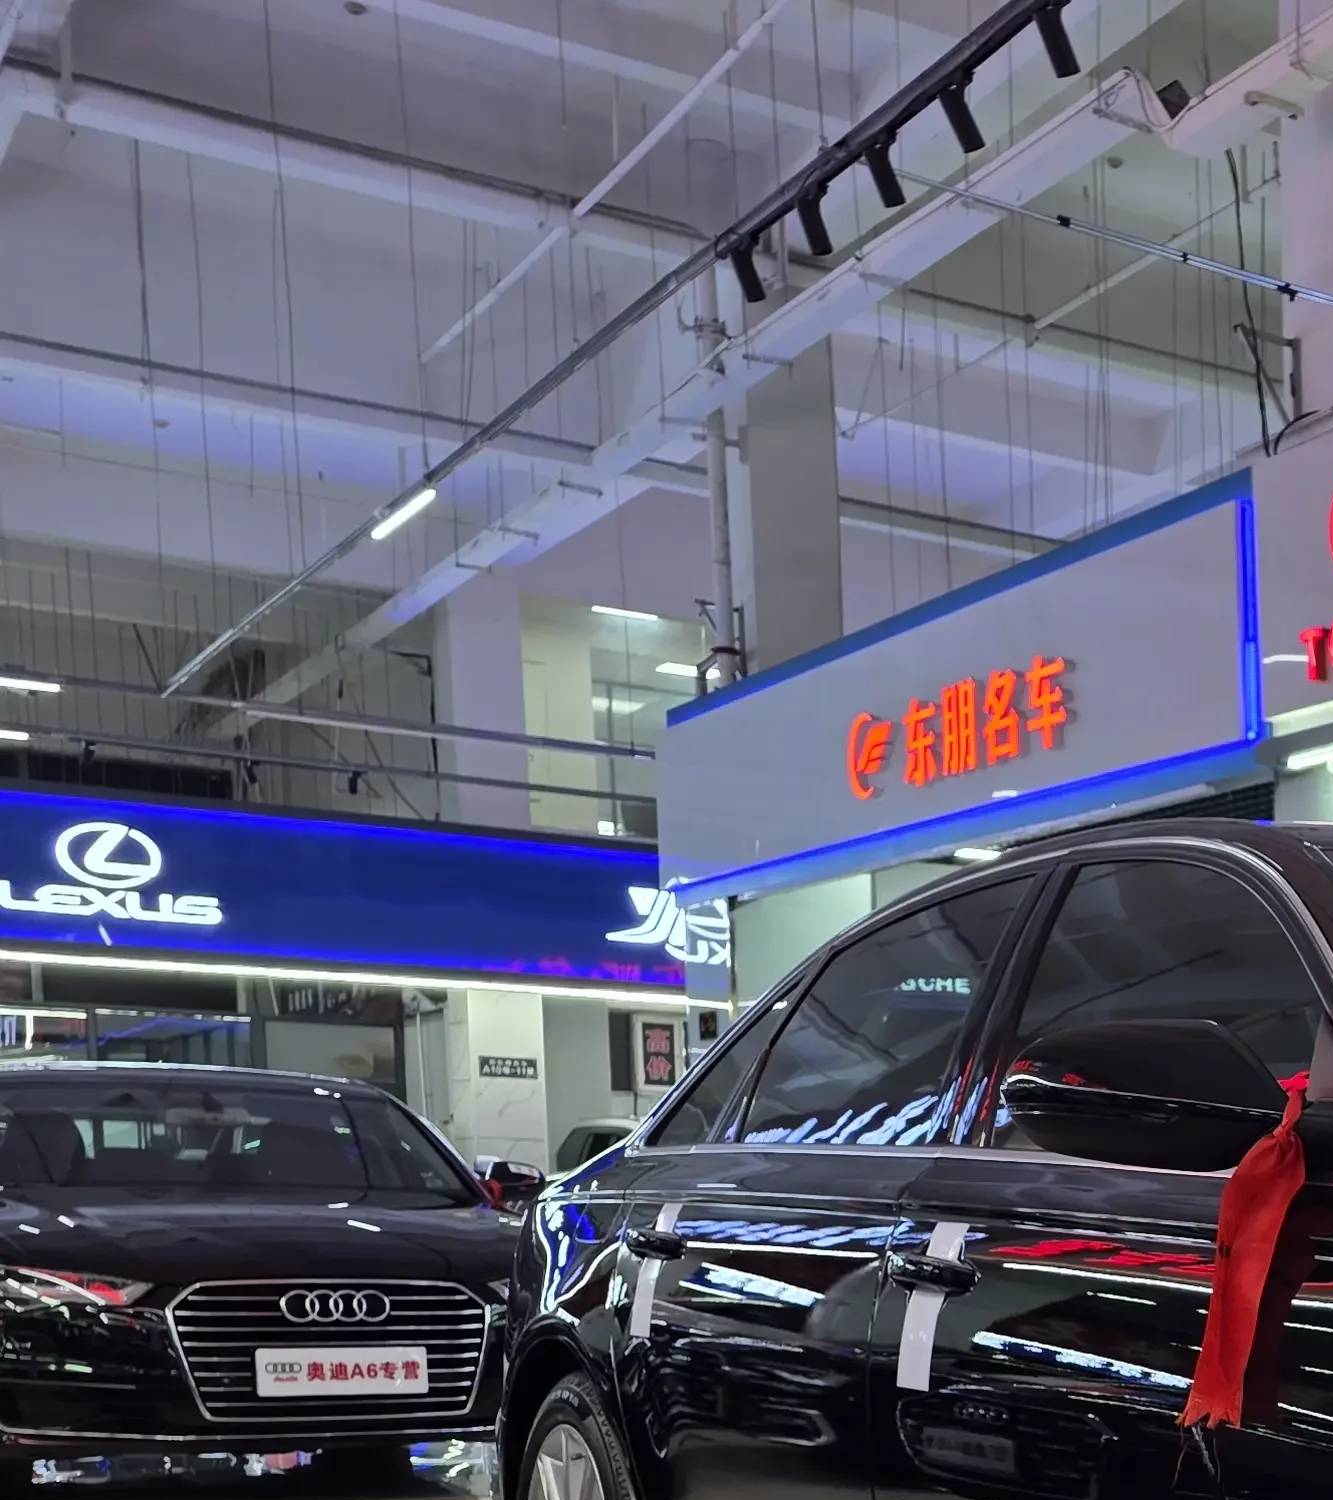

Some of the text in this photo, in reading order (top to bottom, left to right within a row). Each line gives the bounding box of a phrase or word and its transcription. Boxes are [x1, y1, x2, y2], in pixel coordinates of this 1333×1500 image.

[902, 654, 1067, 787] 东朋名车
[0, 879, 223, 925] LEXUS
[645, 1028, 673, 1081] 高价
[307, 1360, 420, 1381] 奥迪A6专营
